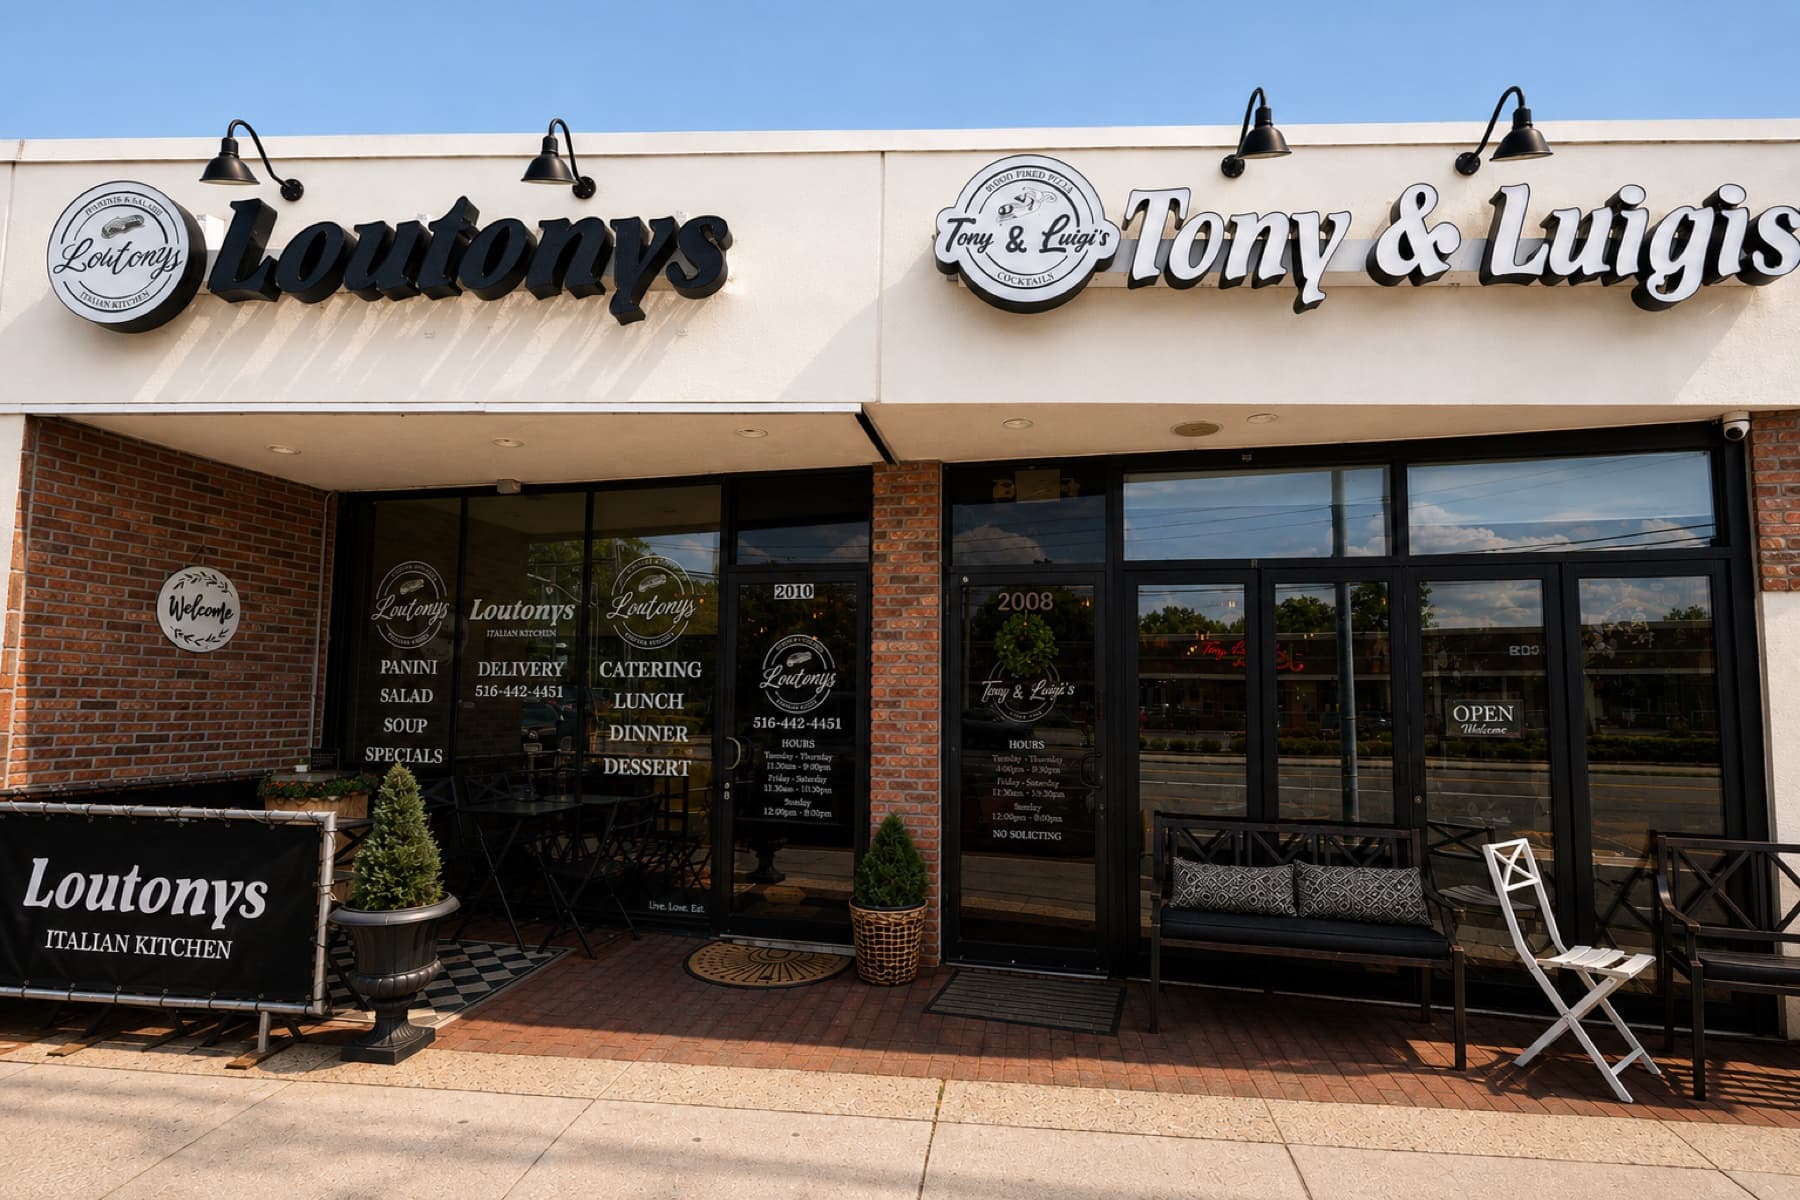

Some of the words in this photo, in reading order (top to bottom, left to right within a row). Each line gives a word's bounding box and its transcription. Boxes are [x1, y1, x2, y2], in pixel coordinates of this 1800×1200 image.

[945, 217, 994, 254] Tony
[1005, 225, 1028, 254] &
[1039, 213, 1111, 254] Luigi's
[1122, 187, 1352, 314] Tony
[1366, 183, 1461, 287] &
[1479, 183, 1800, 311] Luigis
[53, 237, 184, 281] Loutonys
[207, 195, 733, 326] Loutonys
[997, 270, 1056, 287] COCKTAILS
[775, 584, 814, 599] 2010
[169, 593, 234, 625] Welcome
[371, 593, 451, 627] Loutonys
[606, 591, 697, 625] Loutonys
[998, 592, 1054, 611] 2008
[469, 598, 576, 627] Loutonys
[486, 629, 518, 638] ITALIAN
[518, 629, 557, 638] KITCHEN
[380, 659, 439, 676] PANINI
[478, 660, 566, 678] DELIVERY
[600, 660, 703, 679] CATERING
[759, 664, 837, 695] Loutonys
[380, 687, 434, 704] SALAD
[475, 684, 564, 699] 516-442-4451
[1012, 683, 1025, 700] &
[614, 692, 685, 711] LUNCH
[753, 716, 842, 730] 516-442-4451
[1453, 704, 1515, 723] OPEN
[383, 717, 428, 734] SOUP
[610, 724, 689, 743] DINNER
[1461, 723, 1508, 735] Welcome
[781, 738, 816, 749] HOURS
[1008, 739, 1046, 750] HOURS
[365, 746, 443, 764] SPECIALS
[603, 757, 692, 777] DESSERT
[992, 829, 1008, 839] NO
[1008, 830, 1062, 841] SOLICTING
[22, 857, 268, 930] Loutonys
[44, 929, 130, 953] ITALIAN
[133, 935, 233, 960] KITCHEN
